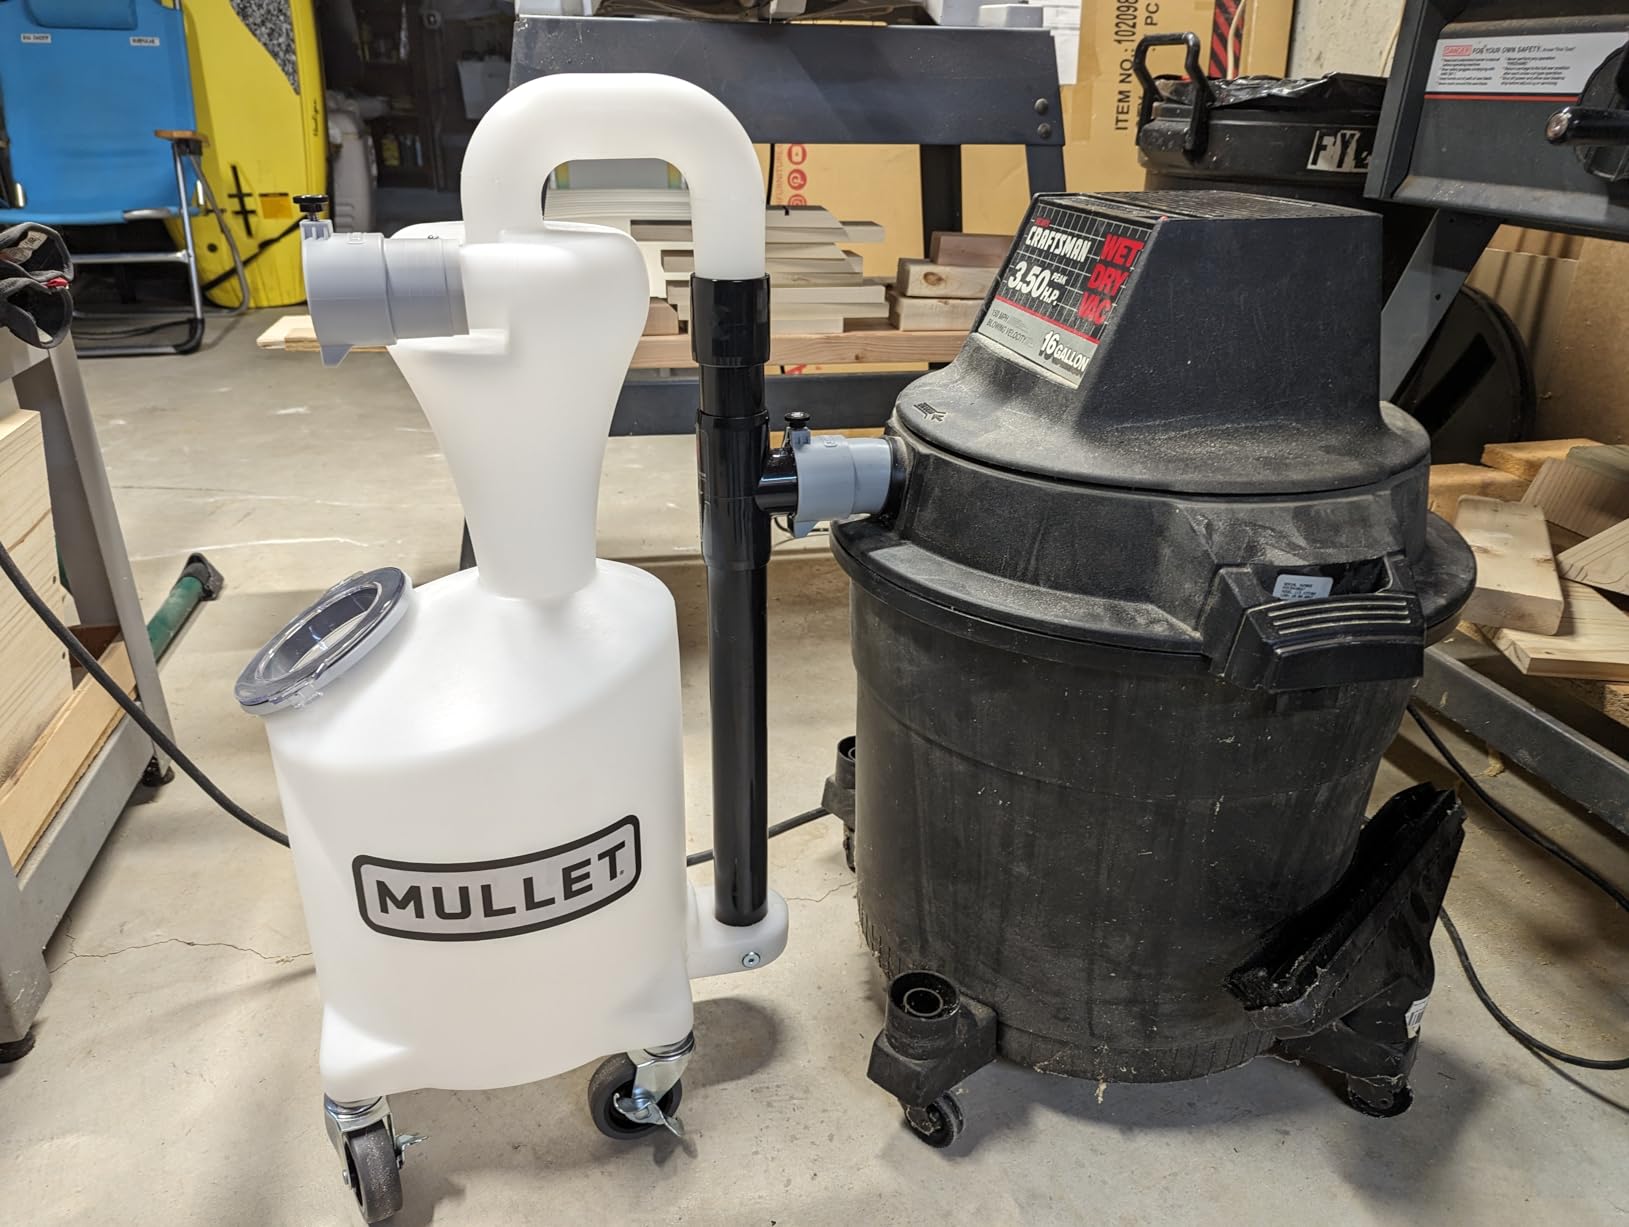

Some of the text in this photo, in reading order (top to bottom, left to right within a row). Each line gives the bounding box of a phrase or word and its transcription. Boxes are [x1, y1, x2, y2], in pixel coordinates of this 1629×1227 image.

[1485, 46, 1501, 54] YOUR
[1517, 45, 1541, 53] SAFETY
[1115, 90, 1132, 131] ITEM
[1025, 226, 1092, 262] CRAFTSMAN
[1100, 233, 1144, 268] WET
[1008, 261, 1051, 298] 3.50
[1051, 272, 1068, 286] PEAK
[1087, 264, 1130, 297] DRY
[1078, 291, 1112, 326] VAC
[1041, 330, 1059, 355] 16
[1053, 344, 1089, 372] GALLON
[375, 840, 626, 920] MULLET
